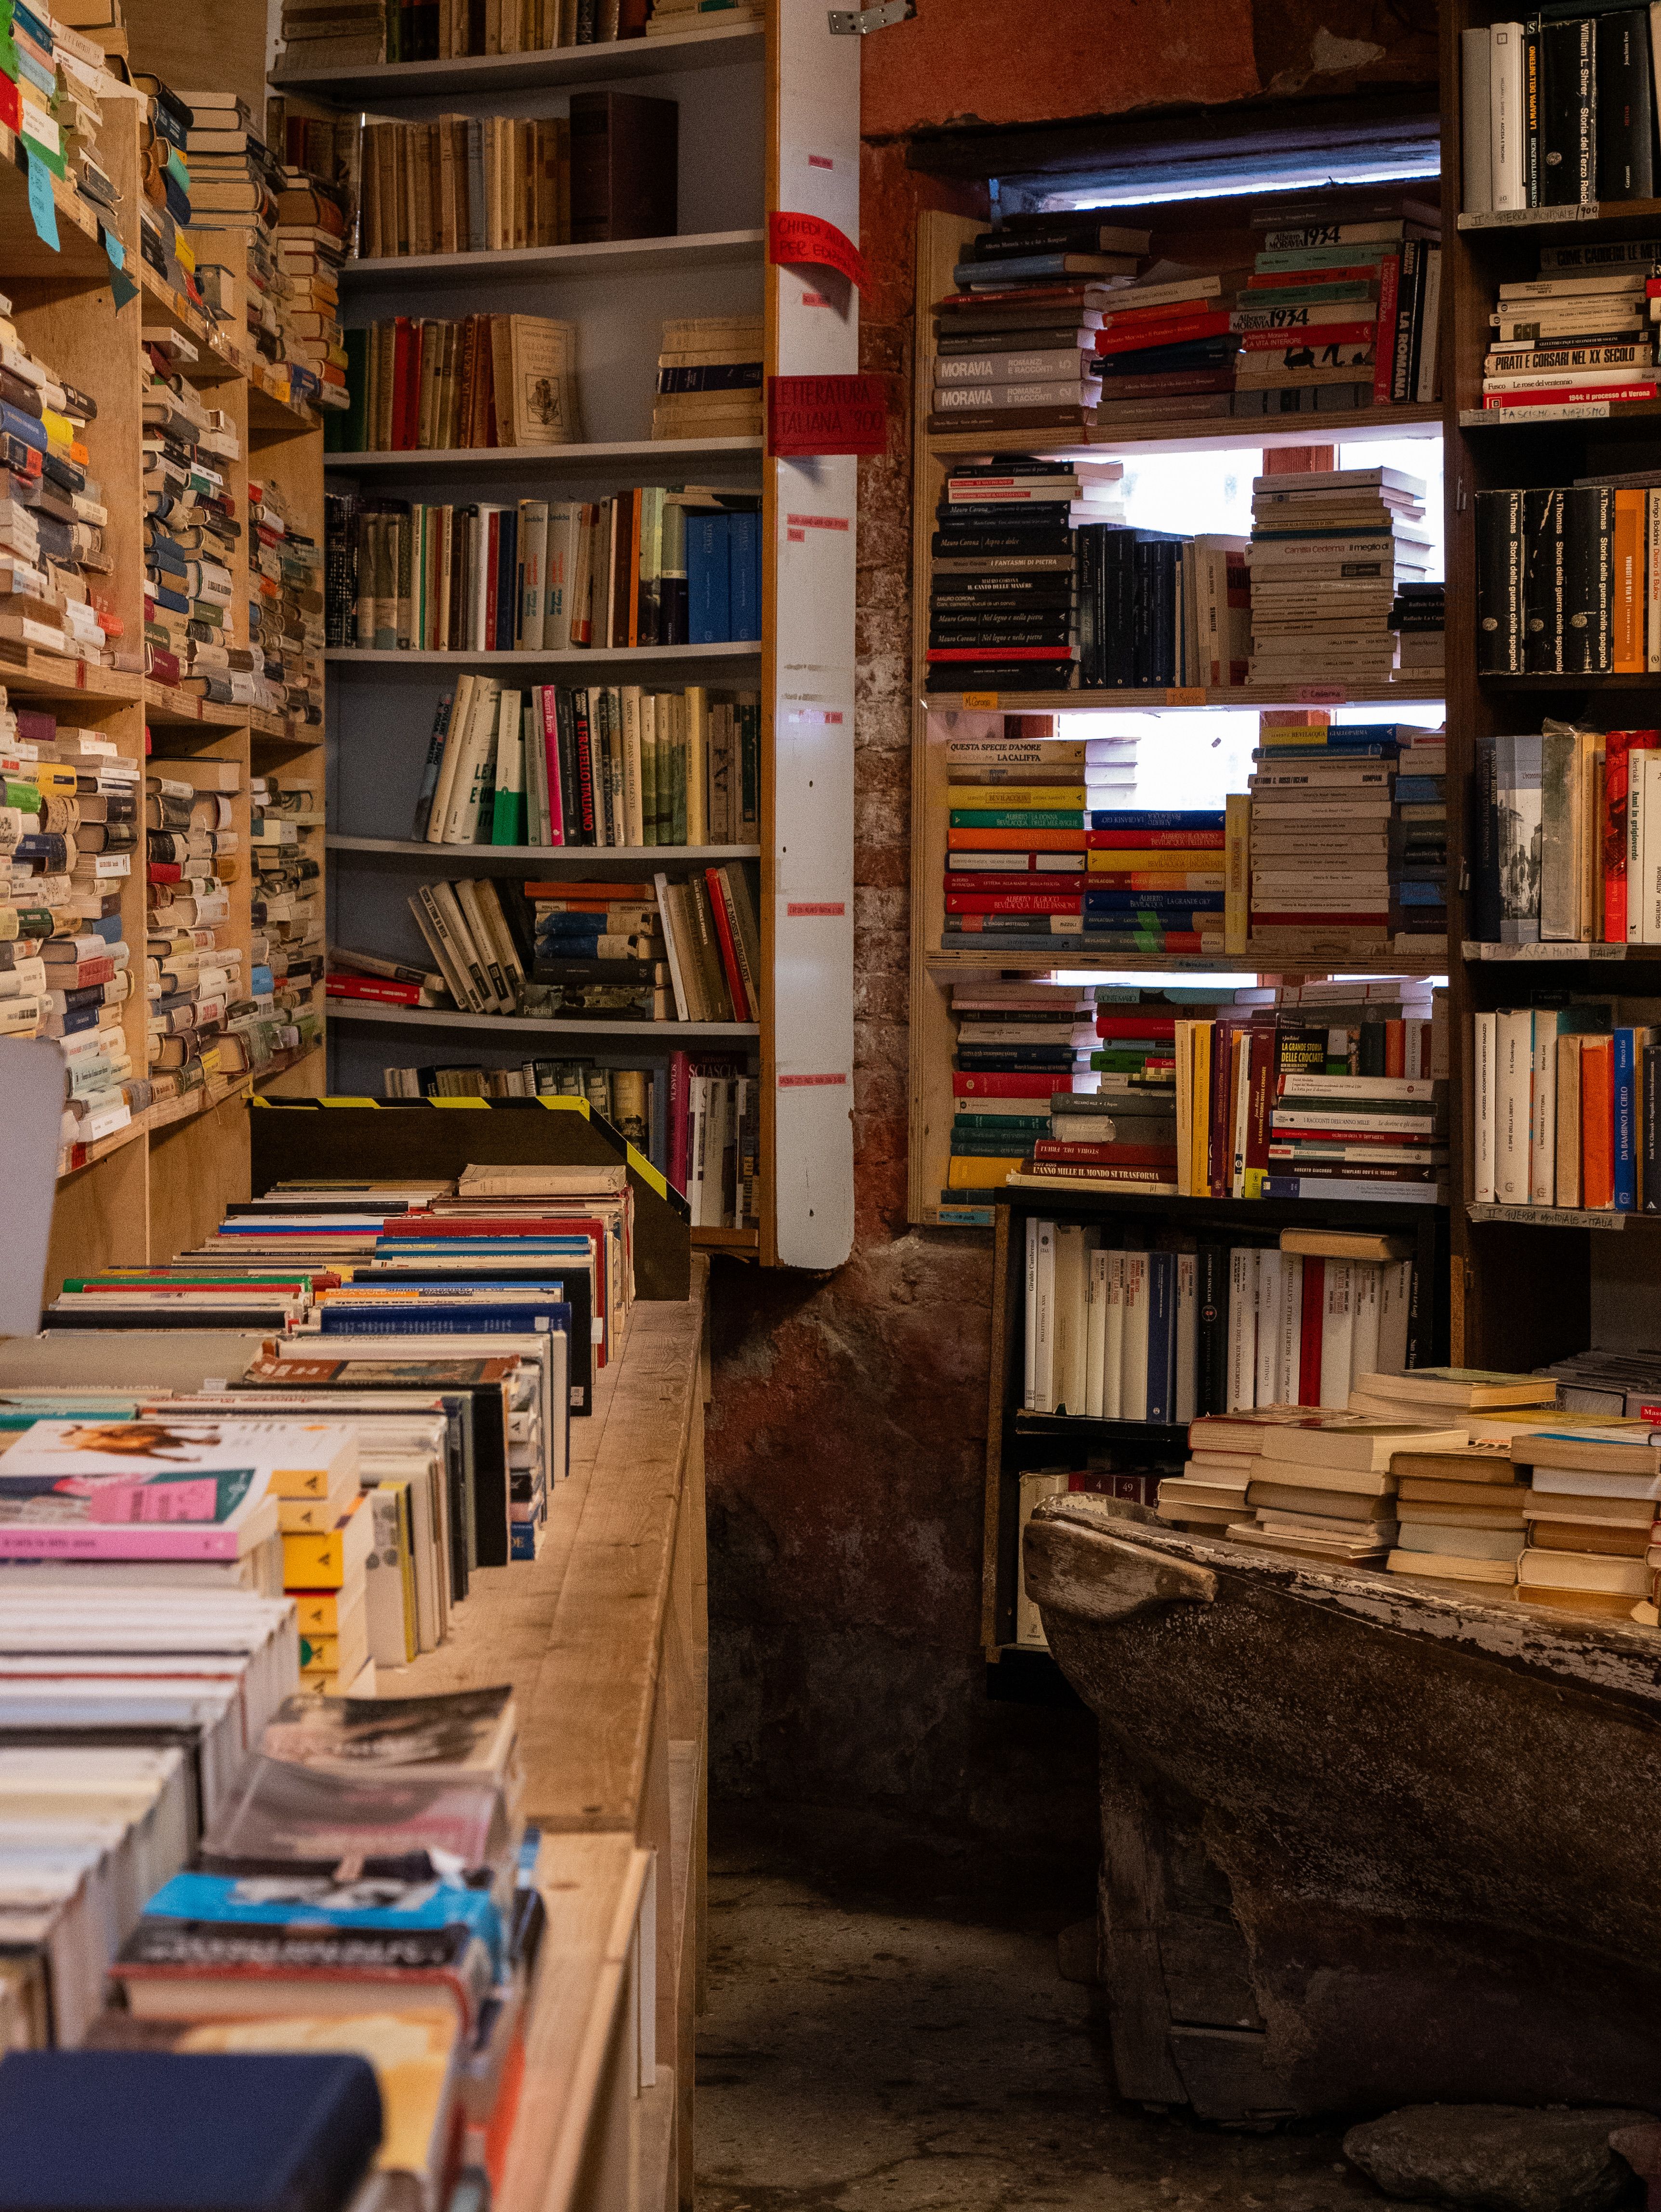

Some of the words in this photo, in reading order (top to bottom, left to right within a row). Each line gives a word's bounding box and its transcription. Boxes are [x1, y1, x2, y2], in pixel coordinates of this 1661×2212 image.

[1580, 23, 1589, 56] William
[1581, 59, 1588, 67] L.
[1580, 69, 1589, 96] Shirer
[1530, 120, 1536, 130] LA
[1580, 107, 1588, 134] Storia
[1580, 136, 1589, 150] del
[1580, 152, 1588, 177] Terzo
[1580, 180, 1589, 205] Reich
[1303, 226, 1341, 245] 1934
[1269, 240, 1304, 249] MORAVIA
[1233, 320, 1270, 329] MORAVIA
[1268, 308, 1309, 328] 1934
[1399, 312, 1410, 329] LA
[1394, 333, 1409, 398] ROMANA
[1495, 356, 1523, 370] PIRATI
[1526, 355, 1529, 368] E
[1533, 352, 1569, 368] CORSARI
[1572, 350, 1585, 366] NEL
[1590, 349, 1601, 364] XX
[1604, 347, 1635, 363] SECOLO
[941, 361, 993, 378] MORAVIA
[1014, 365, 1052, 373] RACCONTI
[941, 391, 993, 407] MORAVIA
[1014, 393, 1052, 402] RACCONTI
[1592, 392, 1620, 401] processo
[776, 409, 843, 433] TALIANA
[1510, 493, 1517, 502] H.
[959, 538, 979, 546] Corona
[985, 538, 1000, 548] Aspro
[1006, 537, 1020, 545] dolce
[1284, 546, 1311, 554] Camilla
[1312, 545, 1345, 553] Cederna
[1353, 543, 1381, 552] meglio
[993, 615, 1007, 623] legno
[993, 635, 1006, 643] legno
[1026, 634, 1042, 643] pietra
[1509, 635, 1517, 671] spagnola
[578, 720, 587, 730] IL
[950, 743, 979, 752] QUESTA
[981, 743, 1007, 751] SPECIE
[1008, 743, 1041, 751] D'AMORE
[578, 731, 591, 781] FRATELLO
[581, 783, 593, 831] ITALIANO
[1631, 820, 1639, 861] grigioverde
[725, 898, 733, 909] LE
[994, 901, 1029, 909] BEVILACQUA
[728, 911, 739, 938] MOSSE
[734, 939, 751, 983] SBAGLIATE
[1281, 1042, 1288, 1052] LA
[1289, 1042, 1305, 1052] GRANDE
[1305, 1043, 1322, 1052] STORIA
[1281, 1052, 1297, 1063] DELLE
[1297, 1053, 1324, 1063] CROCIATE
[688, 1064, 738, 1078] SCIASCIA
[1621, 1150, 1628, 1160] DA
[1087, 1169, 1109, 1177] MONDO
[1119, 1170, 1160, 1181] TRASFORMA
